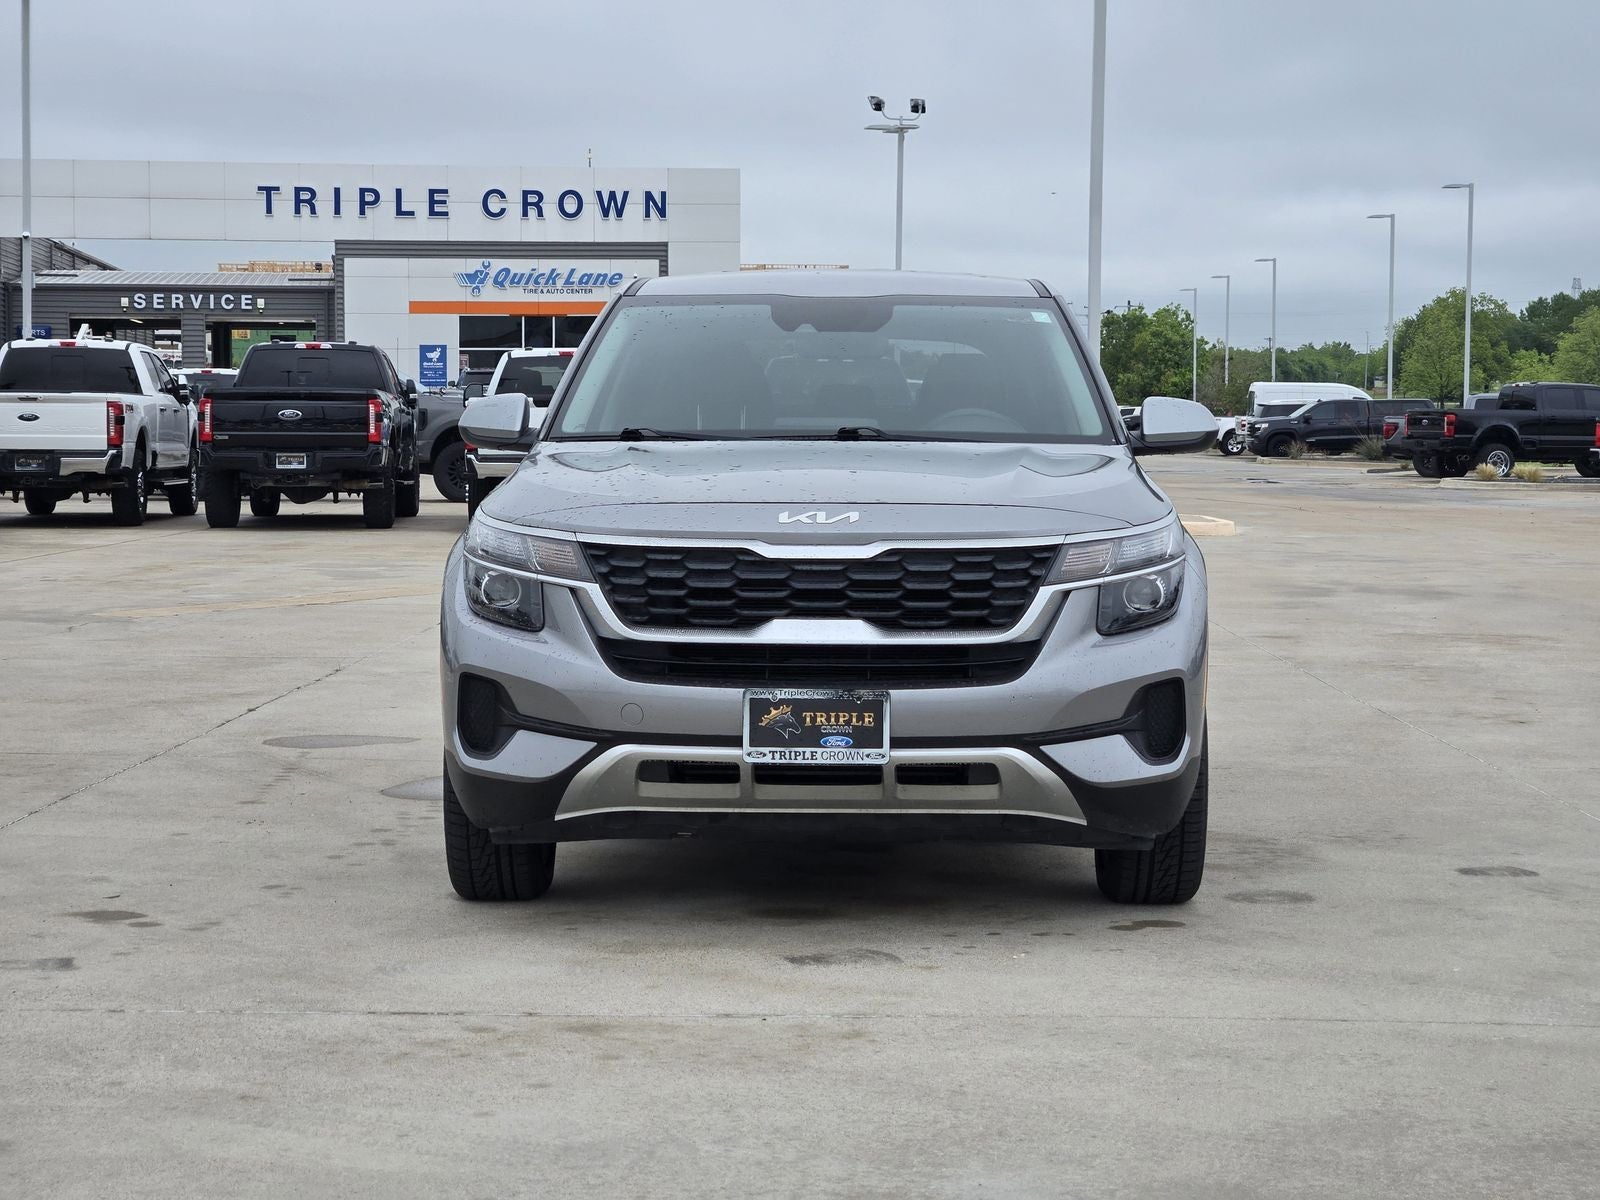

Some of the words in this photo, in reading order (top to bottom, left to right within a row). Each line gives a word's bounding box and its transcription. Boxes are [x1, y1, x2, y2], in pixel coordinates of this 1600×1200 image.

[256, 185, 450, 219] TRIPLE
[481, 188, 668, 220] CROWN
[493, 267, 561, 290] Quick
[564, 267, 624, 287] Lane
[133, 293, 253, 310] SERVICE
[802, 712, 875, 727] TRIPLE
[821, 725, 853, 734] CROWN
[825, 737, 848, 747] Ford
[768, 750, 818, 760] TRIPLE
[820, 750, 864, 761] CROWN
